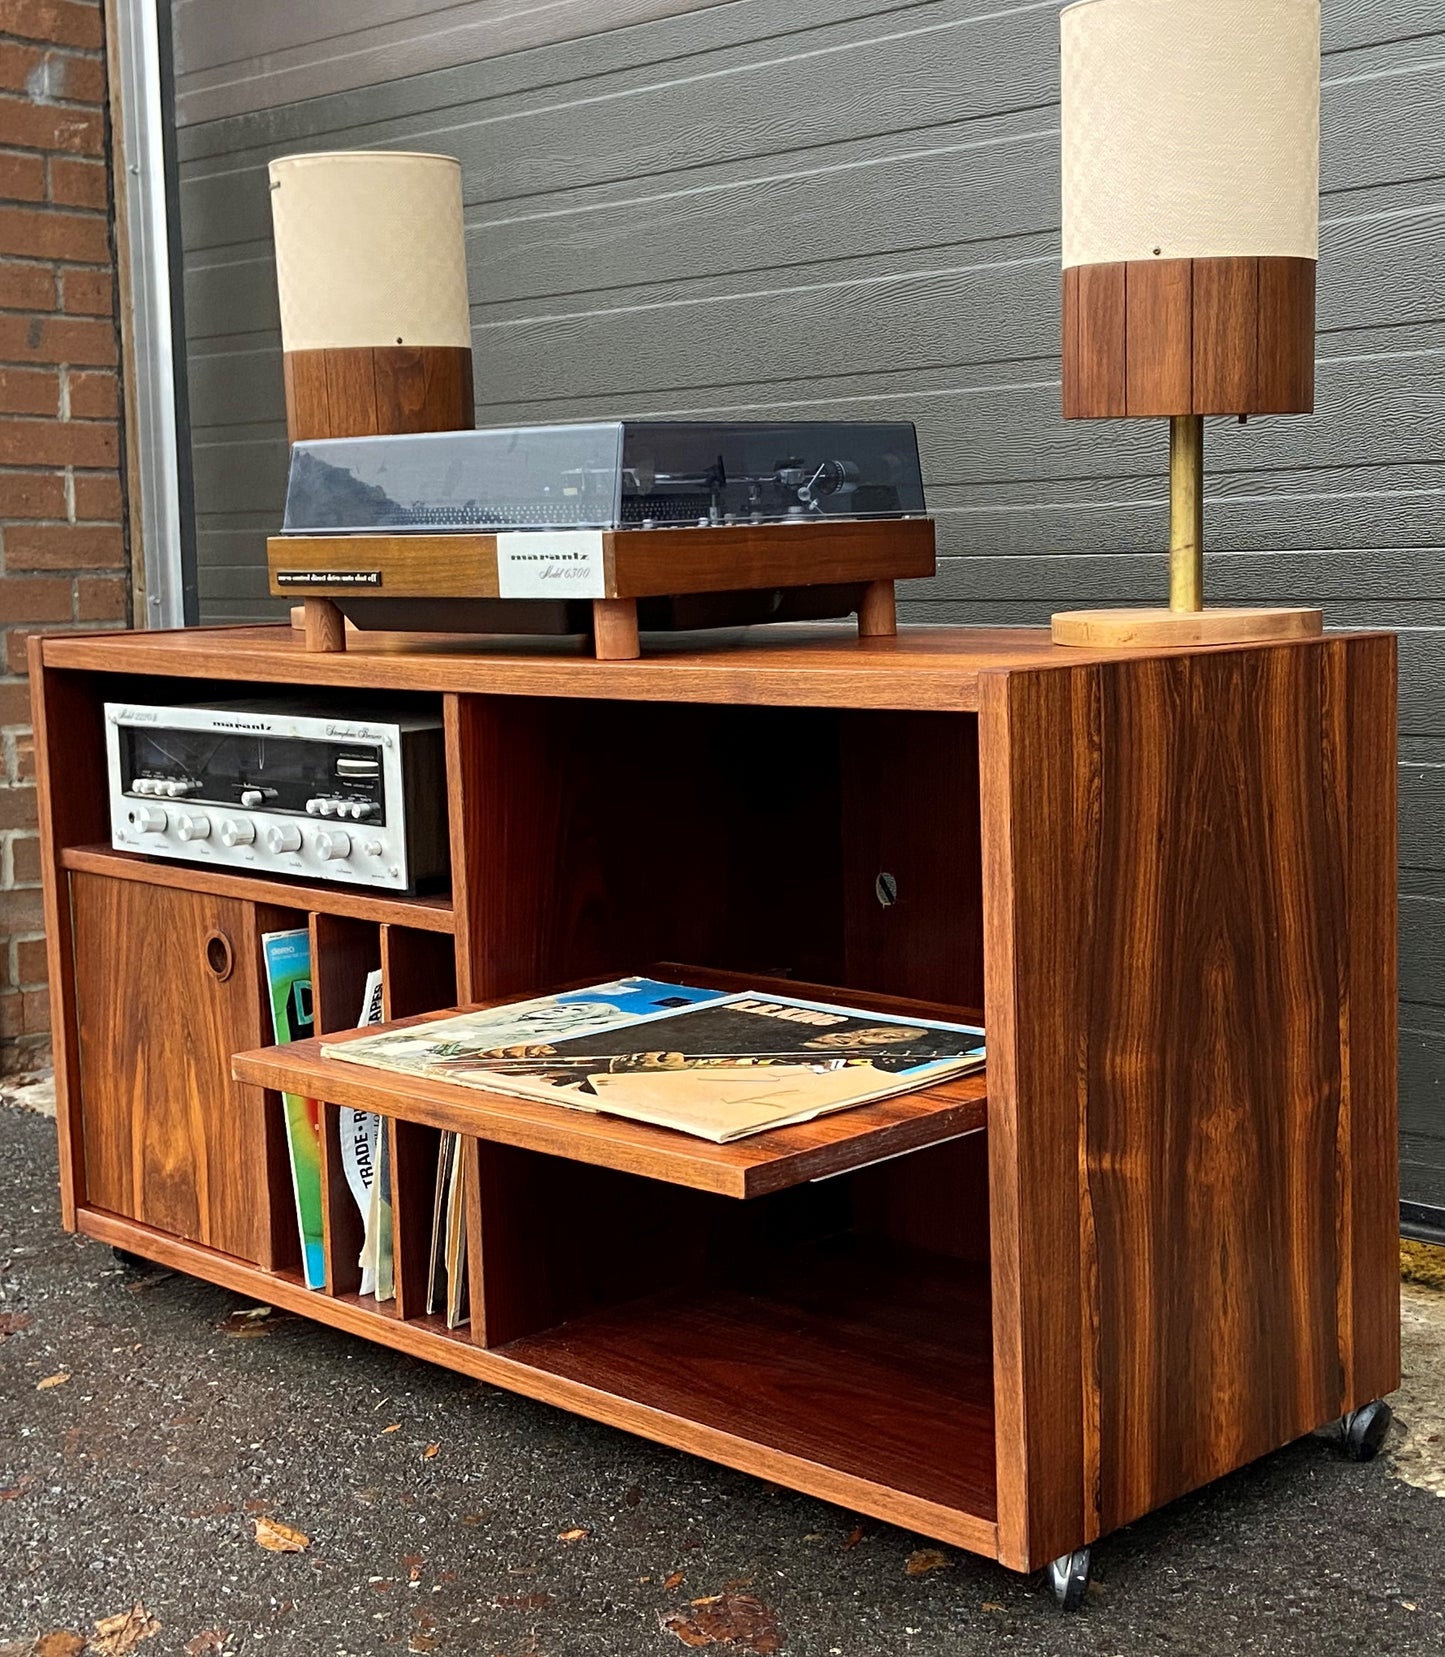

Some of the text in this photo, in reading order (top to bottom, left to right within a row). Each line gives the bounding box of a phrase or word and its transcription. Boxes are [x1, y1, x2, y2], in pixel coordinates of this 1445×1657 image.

[511, 552, 588, 560] marantz
[539, 565, 591, 580] Model 6300
[213, 721, 271, 731] marantz
[354, 1132, 374, 1189] TRADE
